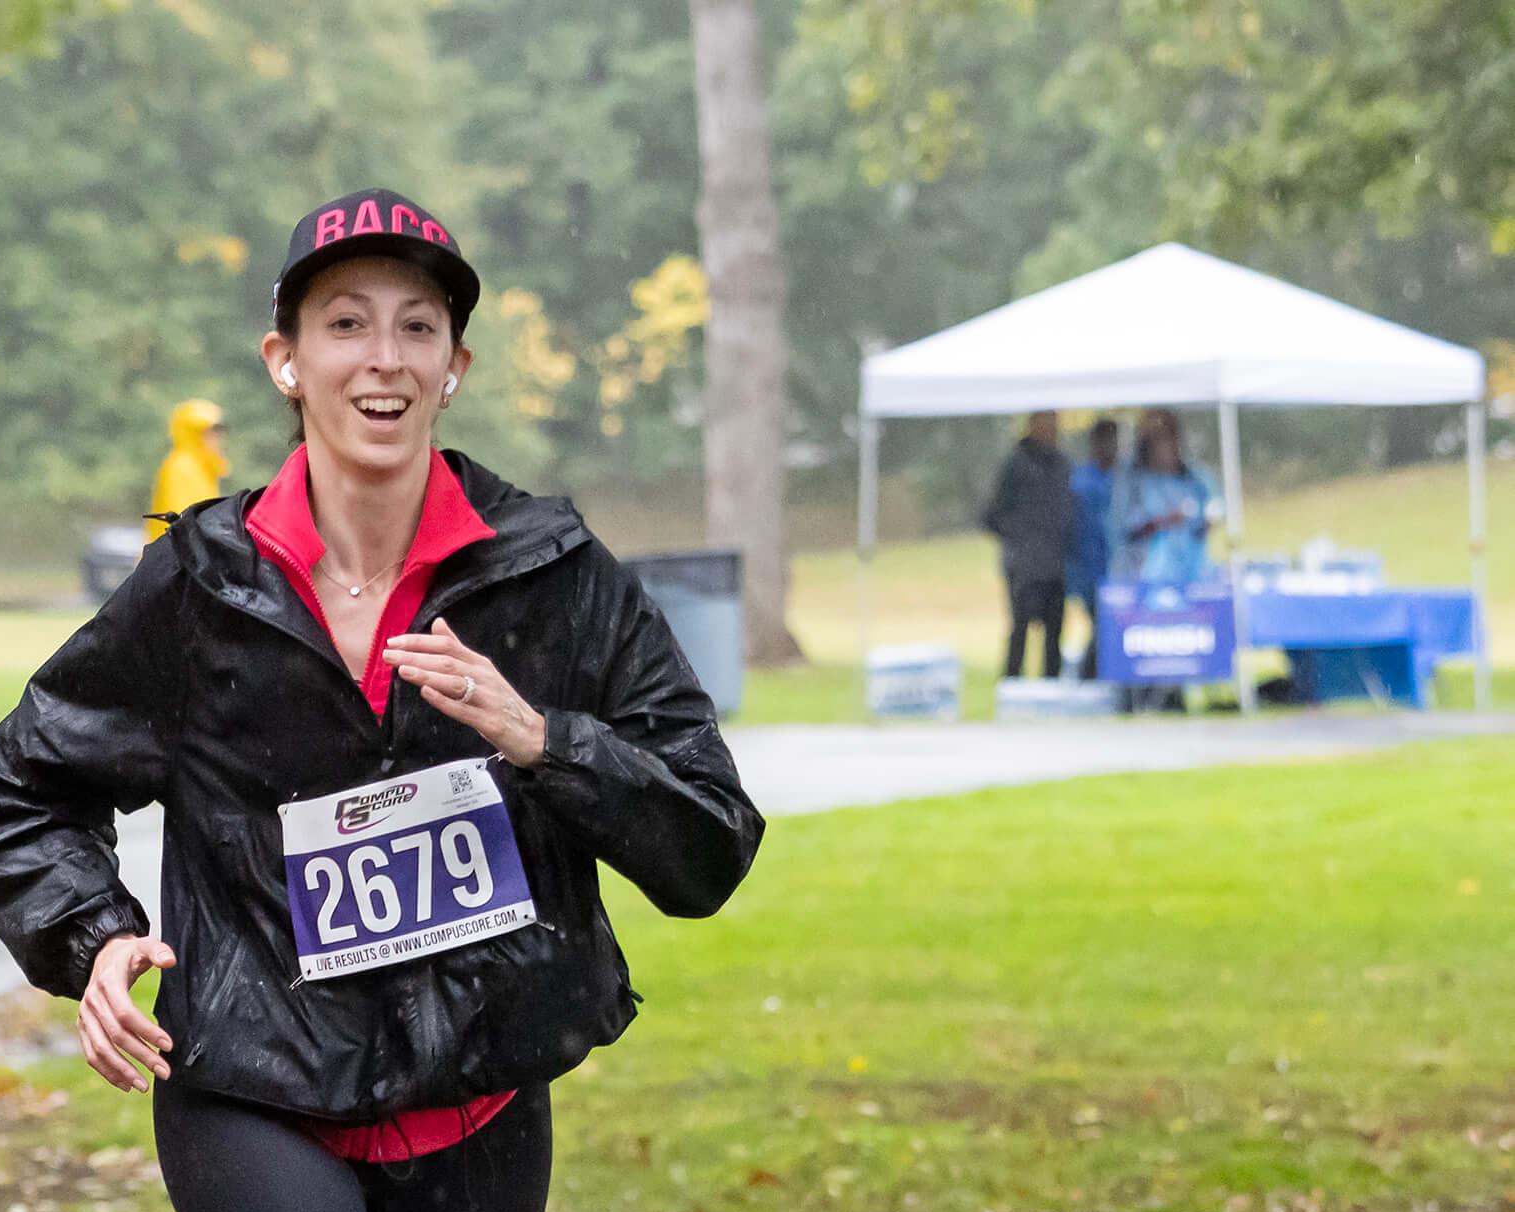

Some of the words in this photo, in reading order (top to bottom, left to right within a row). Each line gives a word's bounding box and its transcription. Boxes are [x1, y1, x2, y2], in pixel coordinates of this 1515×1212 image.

[335, 785, 406, 820] COMPU
[345, 793, 414, 827] SCORE
[304, 820, 494, 945] 2679
[335, 947, 378, 969] RESULTS
[379, 945, 390, 958] @
[392, 909, 518, 955] WWW.COMPUSCORE.COM
